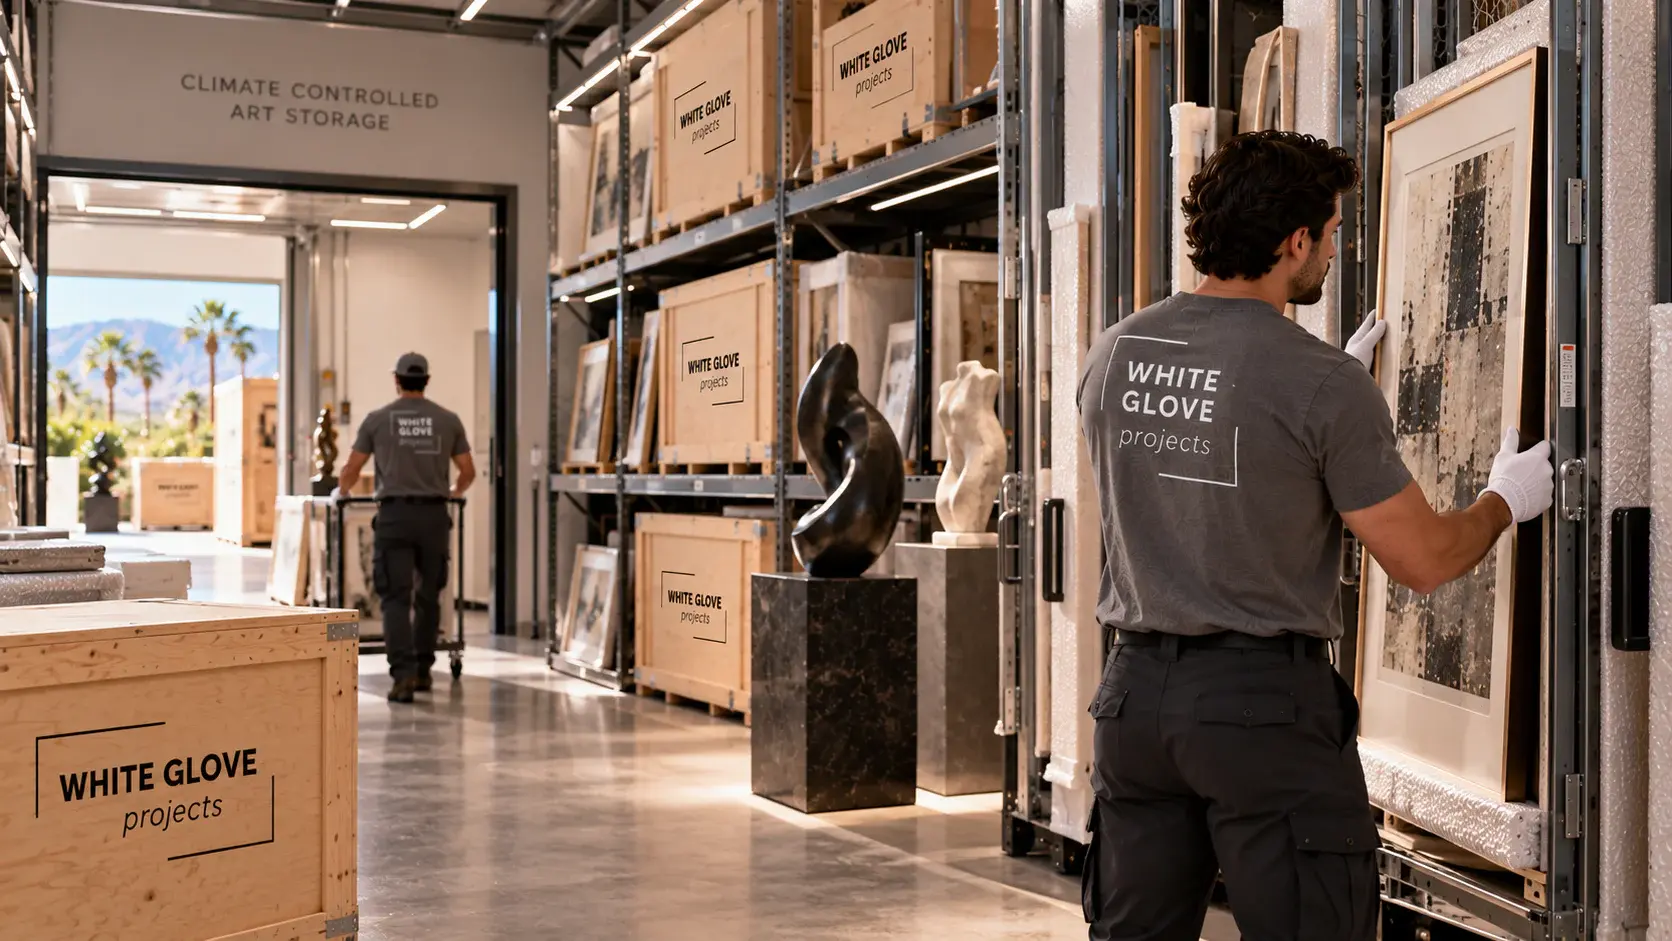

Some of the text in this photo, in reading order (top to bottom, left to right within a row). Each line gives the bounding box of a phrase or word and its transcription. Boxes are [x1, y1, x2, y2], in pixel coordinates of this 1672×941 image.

[839, 31, 907, 80] WHITE GLOVE
[180, 73, 439, 109] CLIMATE CONTROLLED
[855, 67, 893, 98] projects
[230, 104, 390, 131] ART STORAGE
[679, 89, 731, 130] WHITE GLOVE
[691, 119, 720, 145] projects
[687, 352, 740, 375] WHITE GLOVE
[1128, 360, 1221, 392] WHITE
[699, 375, 729, 393] projects
[1121, 389, 1215, 423] GLOVE
[398, 426, 433, 436] GLOVE
[1118, 428, 1211, 455] projects
[667, 589, 722, 610] WHITE GLOVE
[680, 610, 711, 625] projects
[59, 747, 257, 802] WHITE GLOVE
[122, 795, 223, 839] projects
